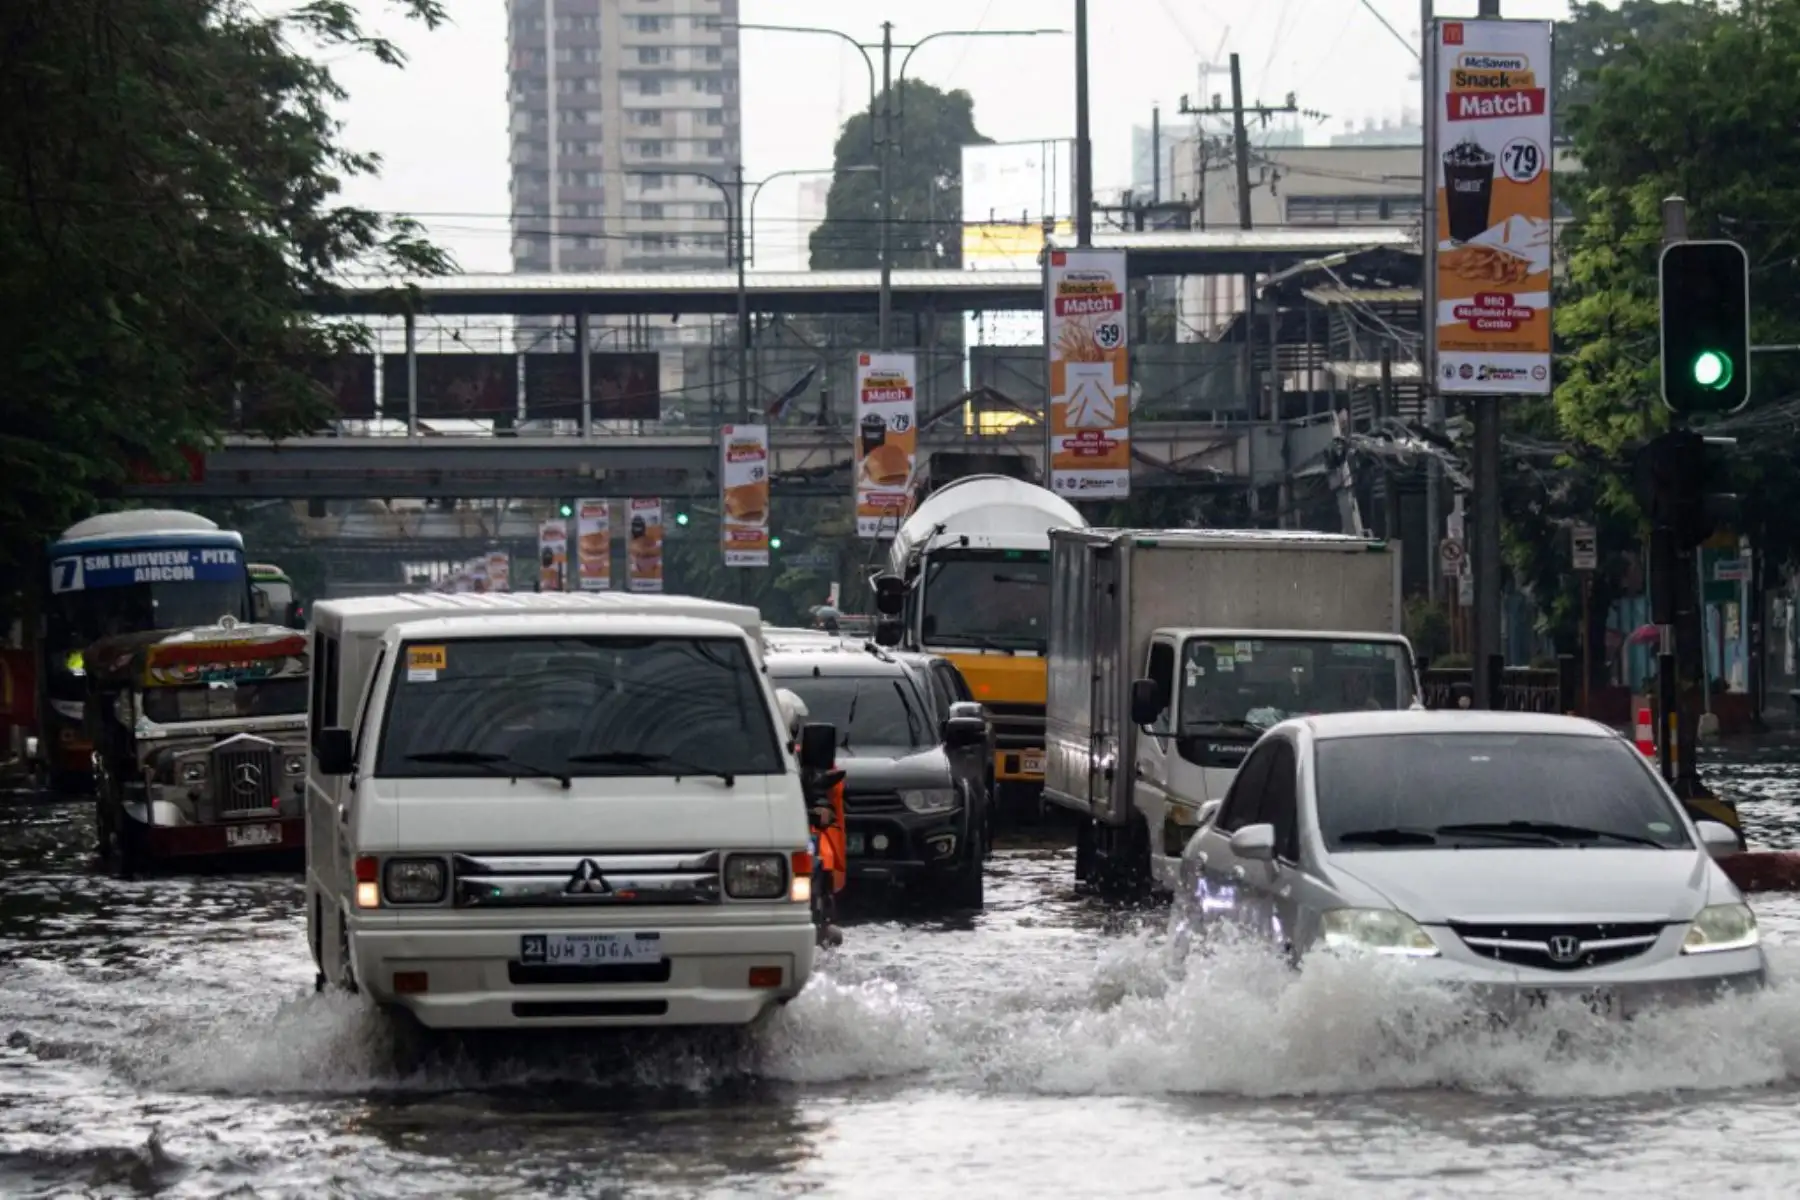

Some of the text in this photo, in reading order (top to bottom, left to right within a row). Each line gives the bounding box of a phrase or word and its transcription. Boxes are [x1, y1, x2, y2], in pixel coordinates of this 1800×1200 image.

[1456, 71, 1511, 88] Snack
[1460, 91, 1532, 117] Match
[1060, 282, 1098, 293] Snack
[1064, 296, 1114, 313] Match
[1477, 319, 1512, 329] Combo
[868, 388, 906, 401] Match
[85, 555, 111, 571] SM
[113, 550, 189, 568] FAIRVIEW
[201, 549, 237, 565] PITX
[53, 559, 78, 590] 7
[134, 566, 195, 583] AIRCON
[524, 940, 545, 956] 21
